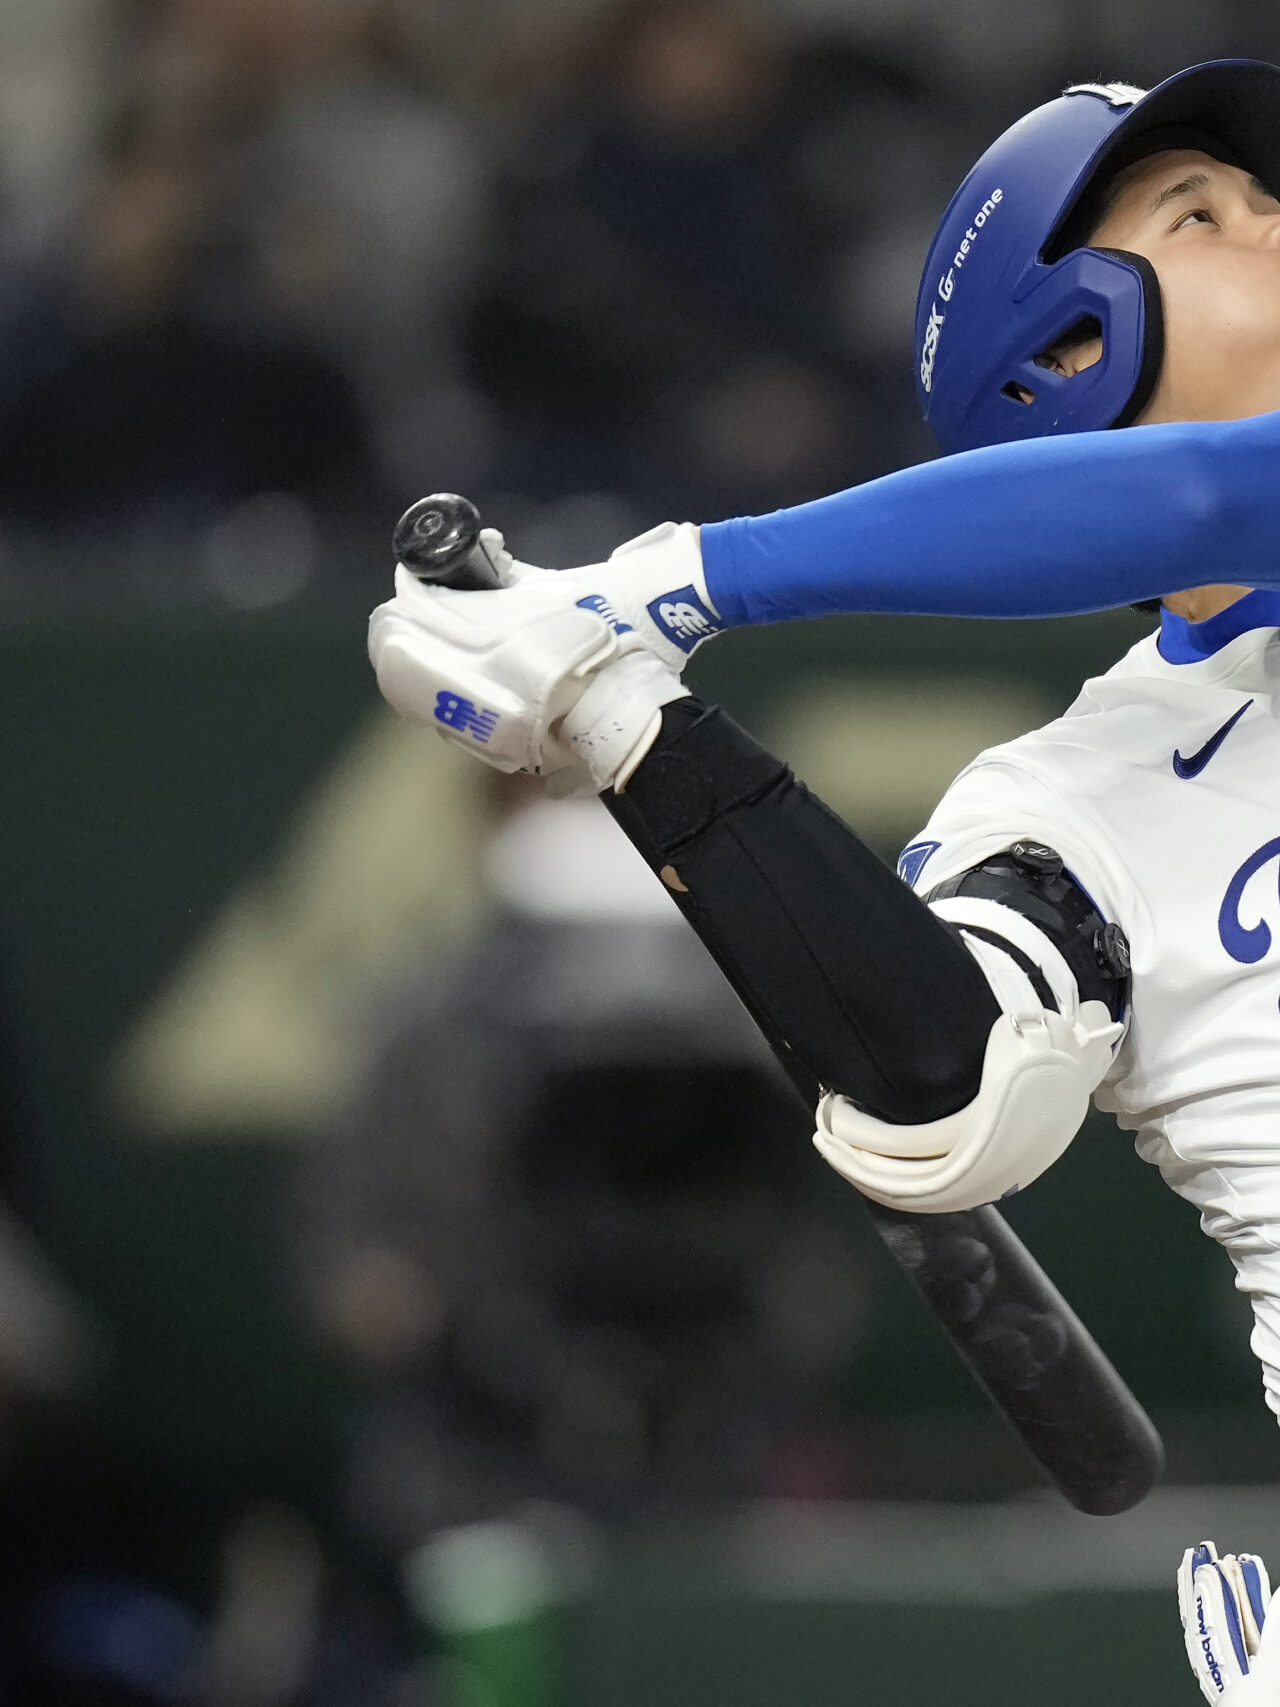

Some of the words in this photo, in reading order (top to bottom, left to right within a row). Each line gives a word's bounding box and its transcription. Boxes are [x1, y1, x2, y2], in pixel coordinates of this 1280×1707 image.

[920, 301, 945, 392] SCSK
[953, 227, 978, 268] net
[974, 188, 1004, 228] one
[1196, 1596, 1208, 1636] new
[1201, 1636, 1225, 1693] balan
